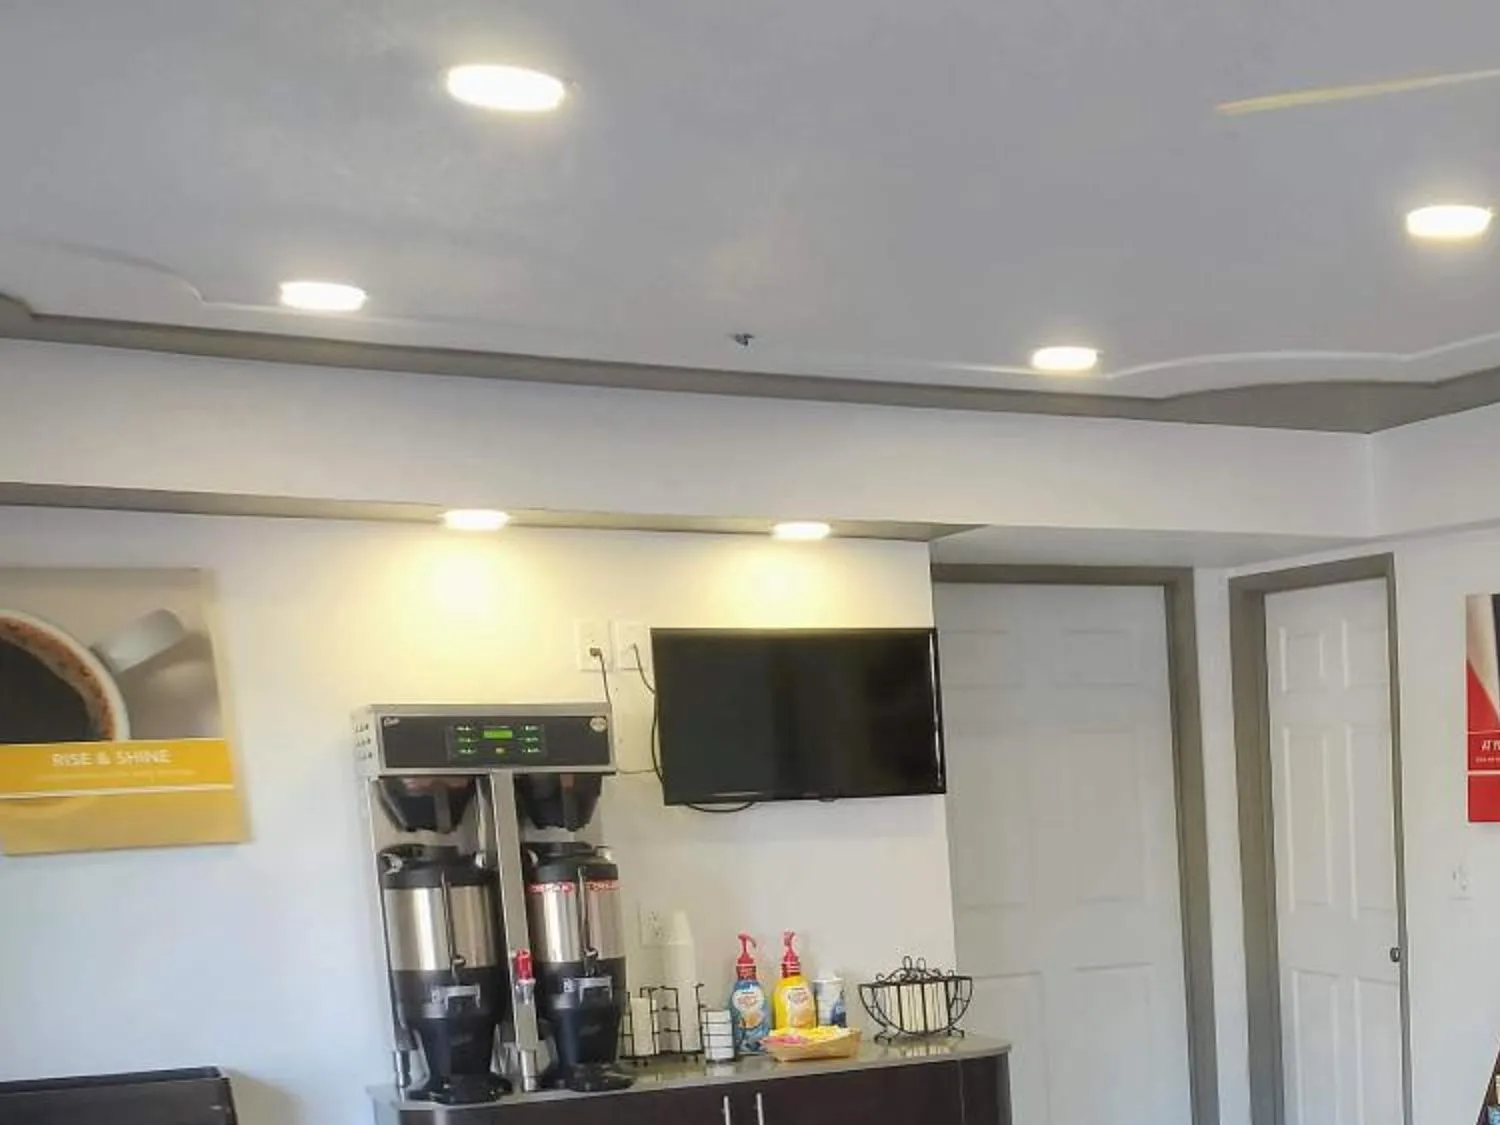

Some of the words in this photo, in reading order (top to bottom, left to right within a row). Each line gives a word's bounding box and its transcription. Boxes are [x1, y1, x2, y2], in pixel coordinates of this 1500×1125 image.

[1481, 740, 1491, 751] AT
[52, 753, 92, 767] RISE
[97, 752, 111, 765] &
[116, 750, 171, 764] SHINE
